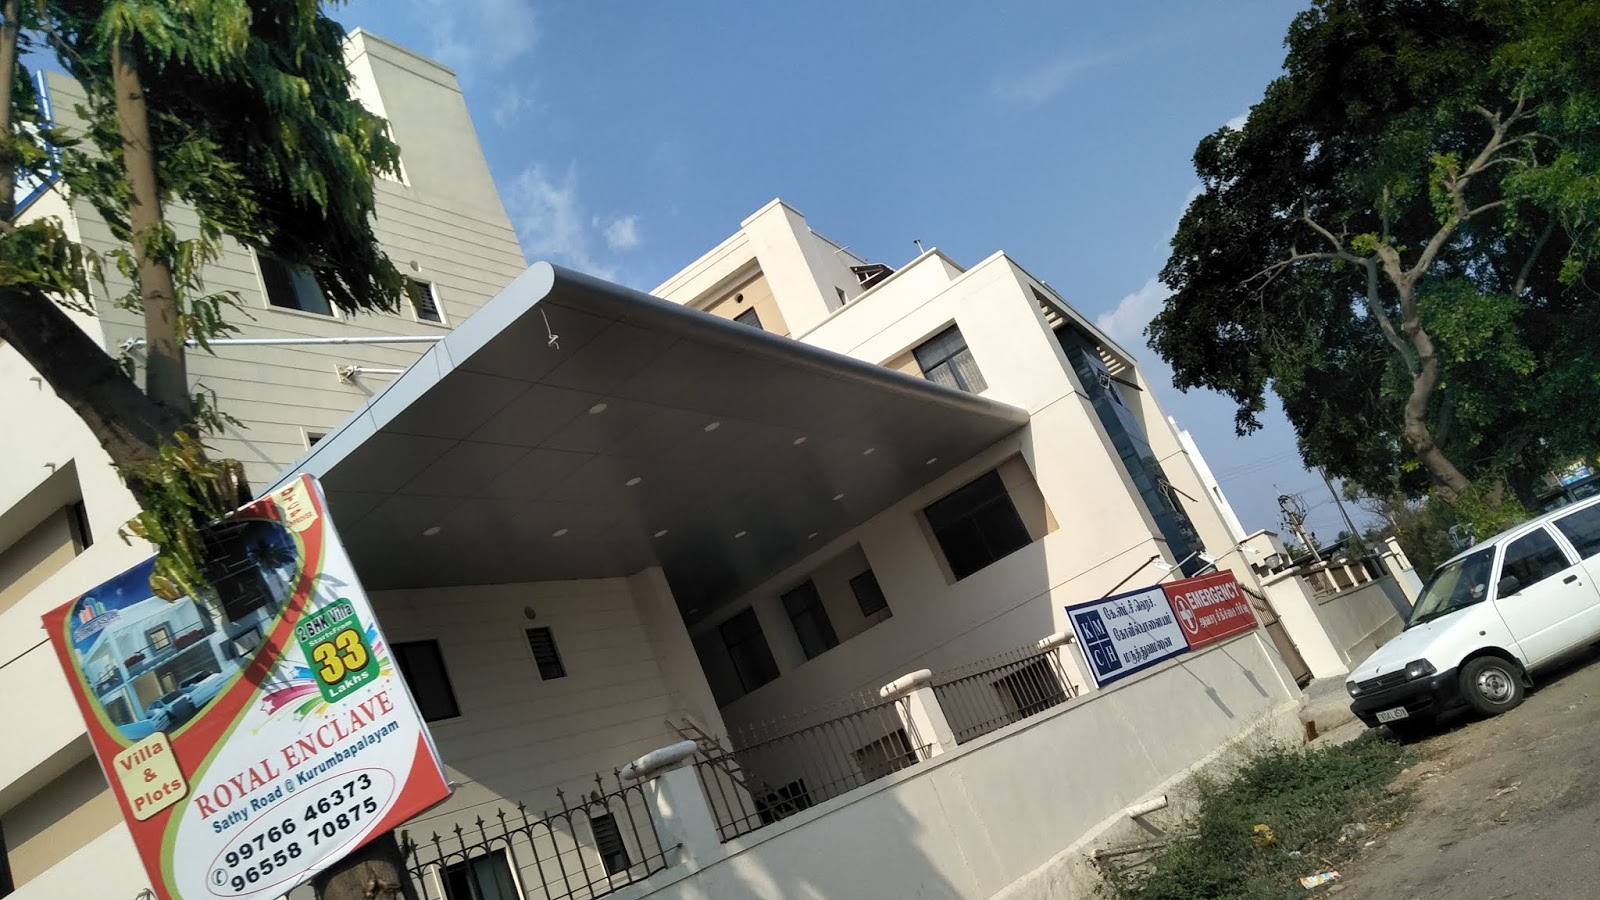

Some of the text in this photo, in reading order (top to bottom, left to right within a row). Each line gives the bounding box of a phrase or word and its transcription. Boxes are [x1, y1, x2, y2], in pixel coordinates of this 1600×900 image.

[1185, 581, 1240, 610] EMERGENCY
[297, 604, 353, 642] 2 BHK Villa
[312, 628, 369, 685] 33
[328, 671, 370, 698] Lakhs
[119, 742, 164, 770] Villa
[194, 690, 394, 820] ROYAL ENCLAVE
[143, 767, 158, 783] &
[212, 720, 400, 834] Sathy Road @ Kurumbapalayam
[134, 779, 182, 812] Plots
[225, 773, 372, 868] 99766 46373
[231, 796, 378, 892] 96558 70875
